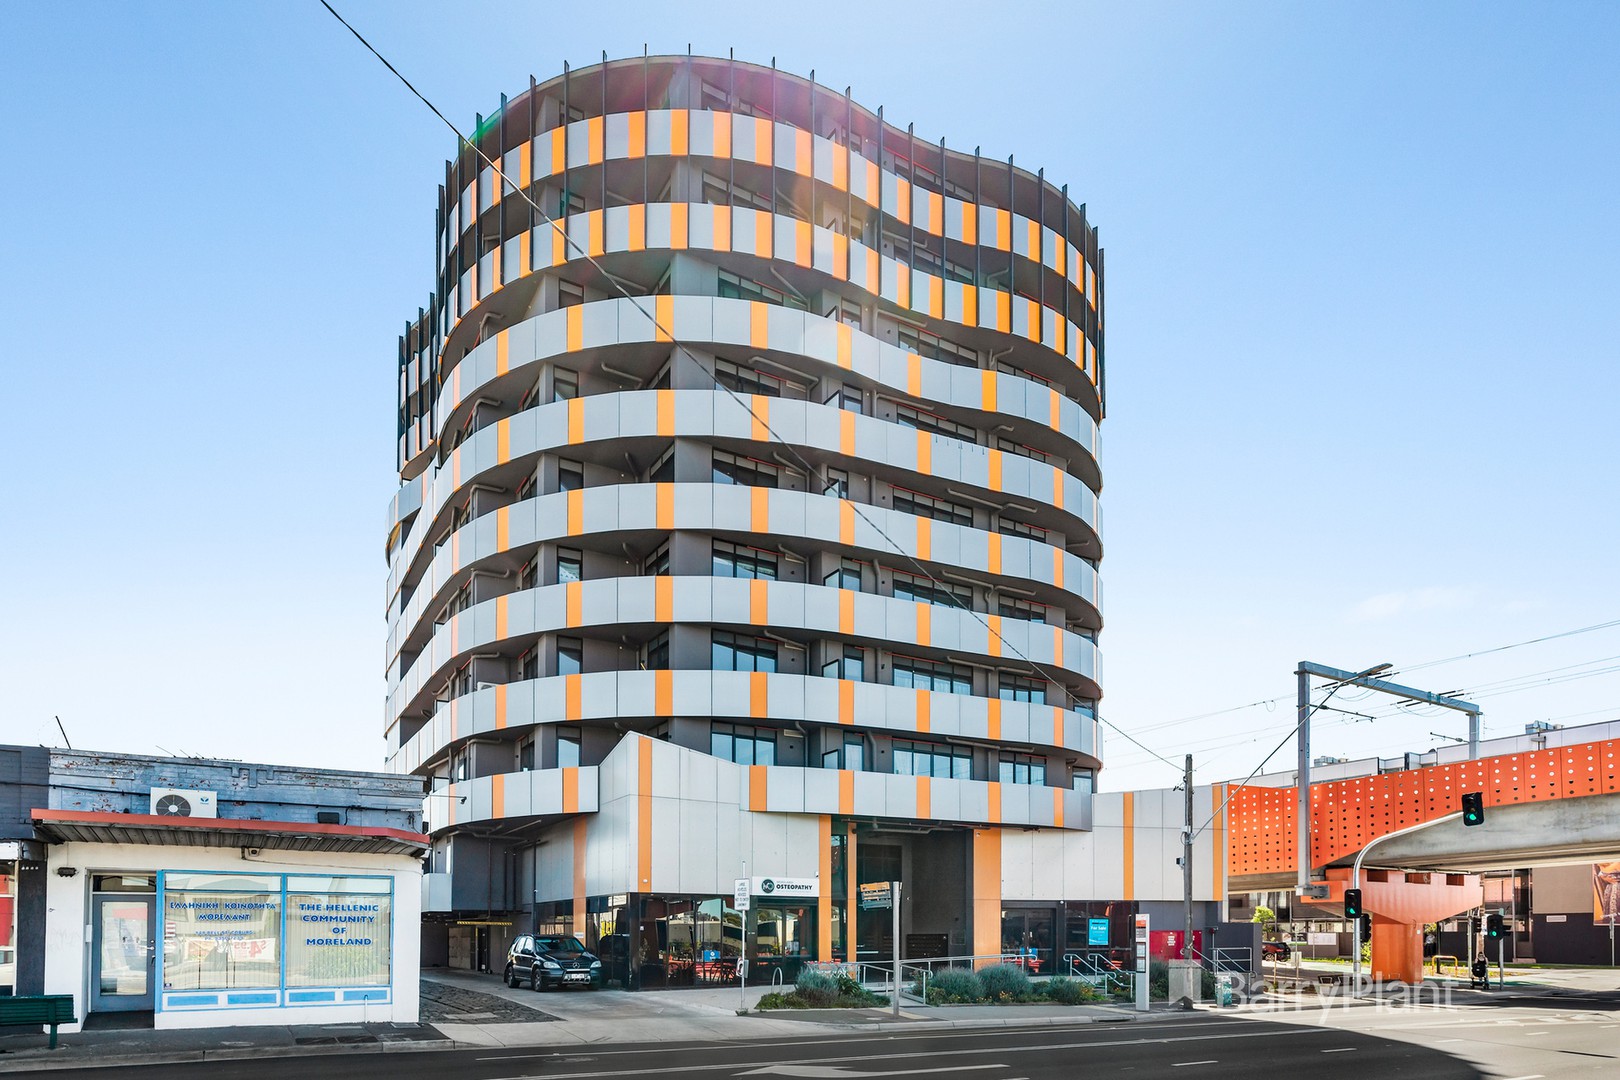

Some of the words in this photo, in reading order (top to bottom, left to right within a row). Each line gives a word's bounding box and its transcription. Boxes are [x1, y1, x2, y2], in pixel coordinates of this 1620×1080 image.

[326, 904, 379, 912] HELLENIC
[302, 915, 375, 923] COMMUNITY
[306, 938, 372, 946] MORELAND
